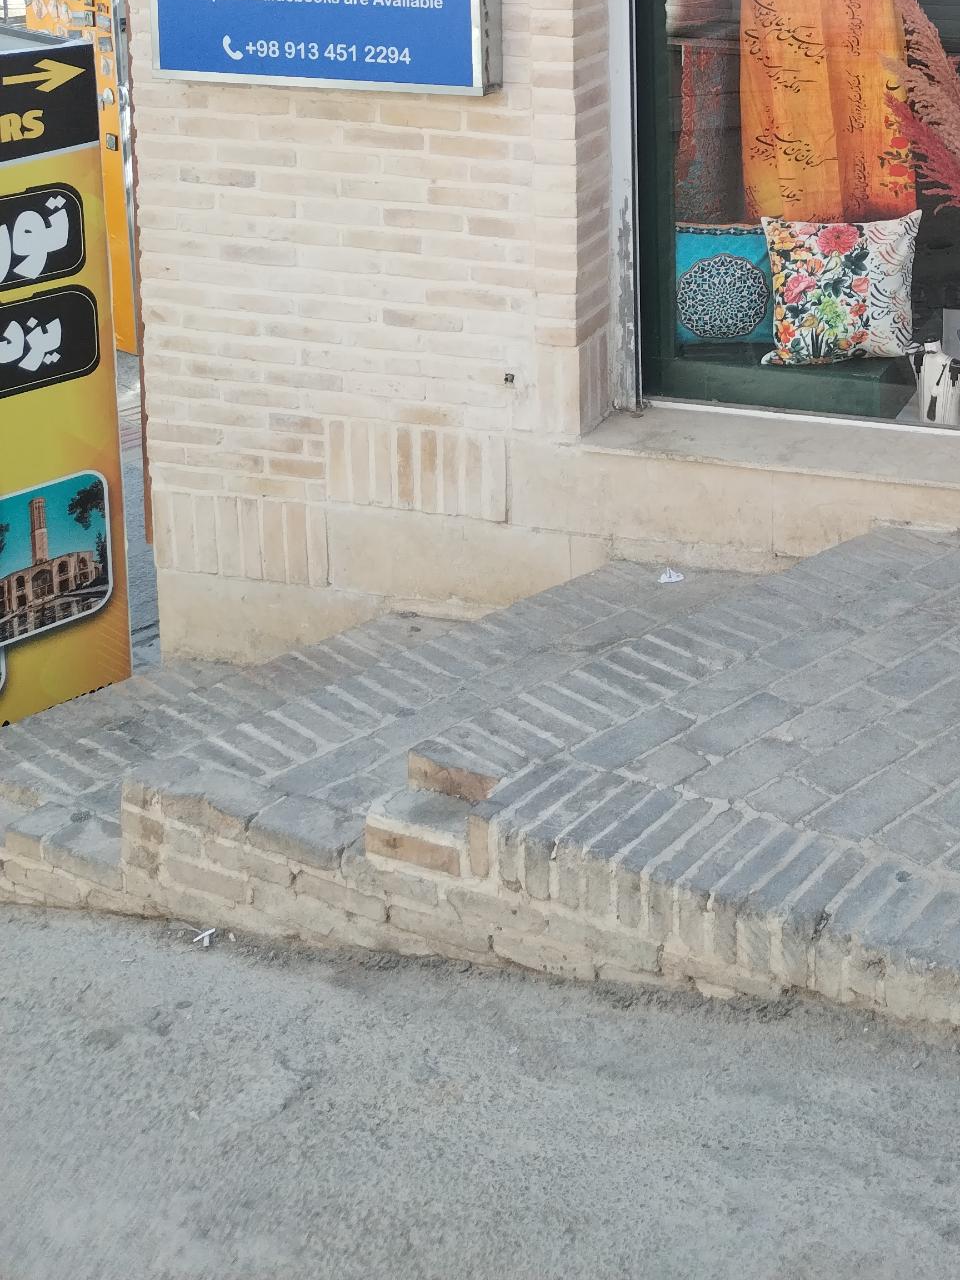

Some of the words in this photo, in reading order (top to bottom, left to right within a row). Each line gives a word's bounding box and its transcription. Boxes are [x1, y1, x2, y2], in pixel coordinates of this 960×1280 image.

[246, 40, 279, 57] +98
[285, 42, 318, 59] 913
[324, 44, 356, 61] 451
[365, 46, 411, 64] 2294
